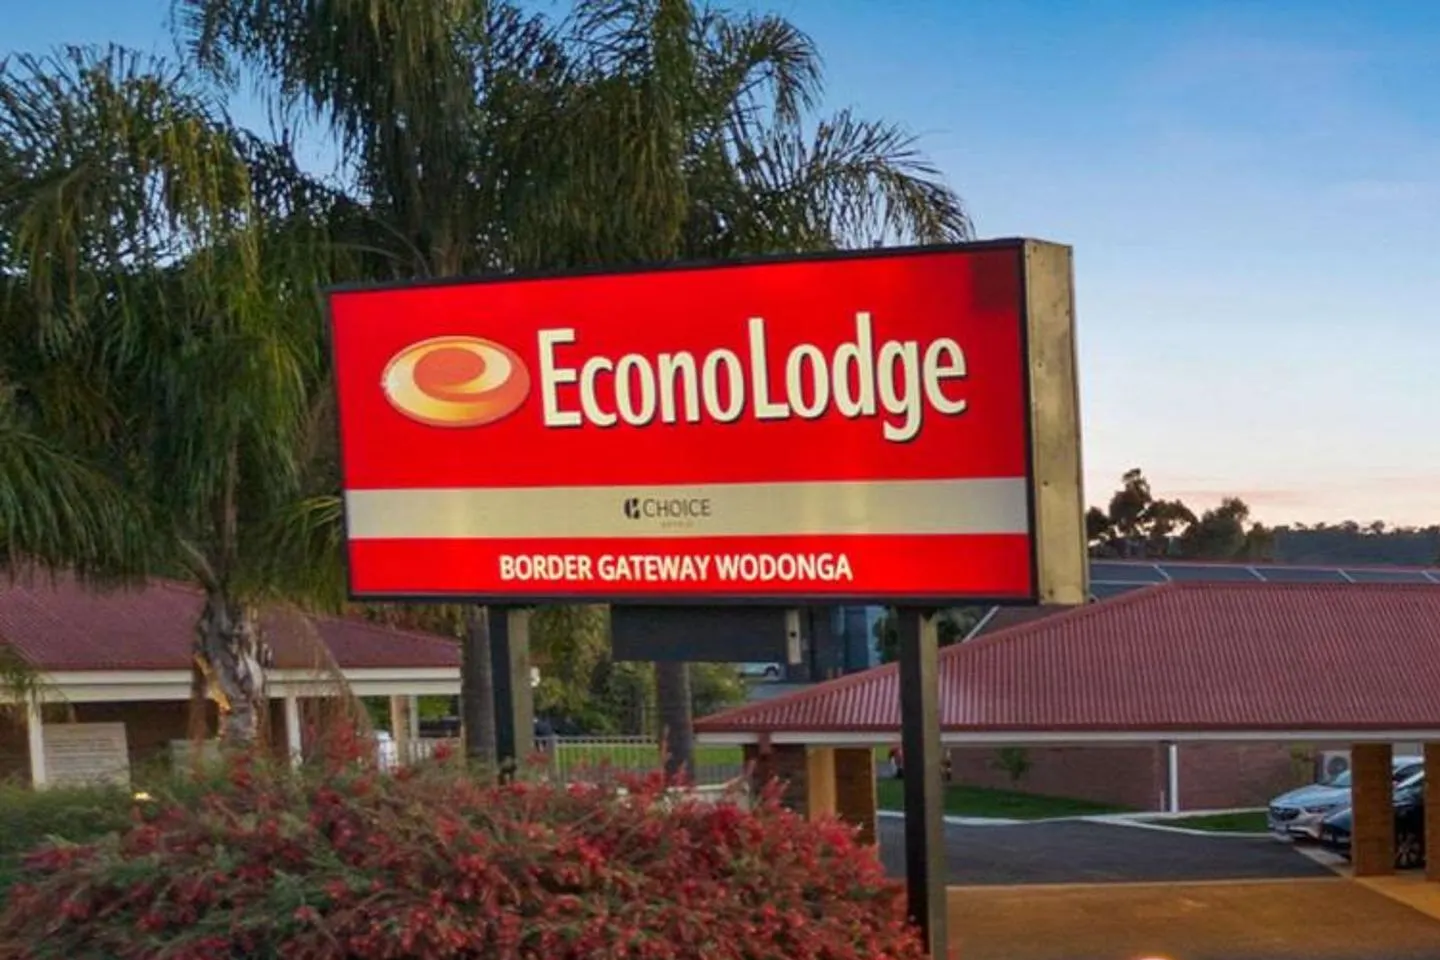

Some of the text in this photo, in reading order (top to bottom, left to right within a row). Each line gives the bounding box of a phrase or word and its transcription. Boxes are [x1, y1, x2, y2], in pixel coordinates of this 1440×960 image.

[537, 312, 967, 442] EconoLodge
[643, 498, 712, 518] CHOICE
[500, 552, 854, 580] BORDER GATEWAY WODONGA
